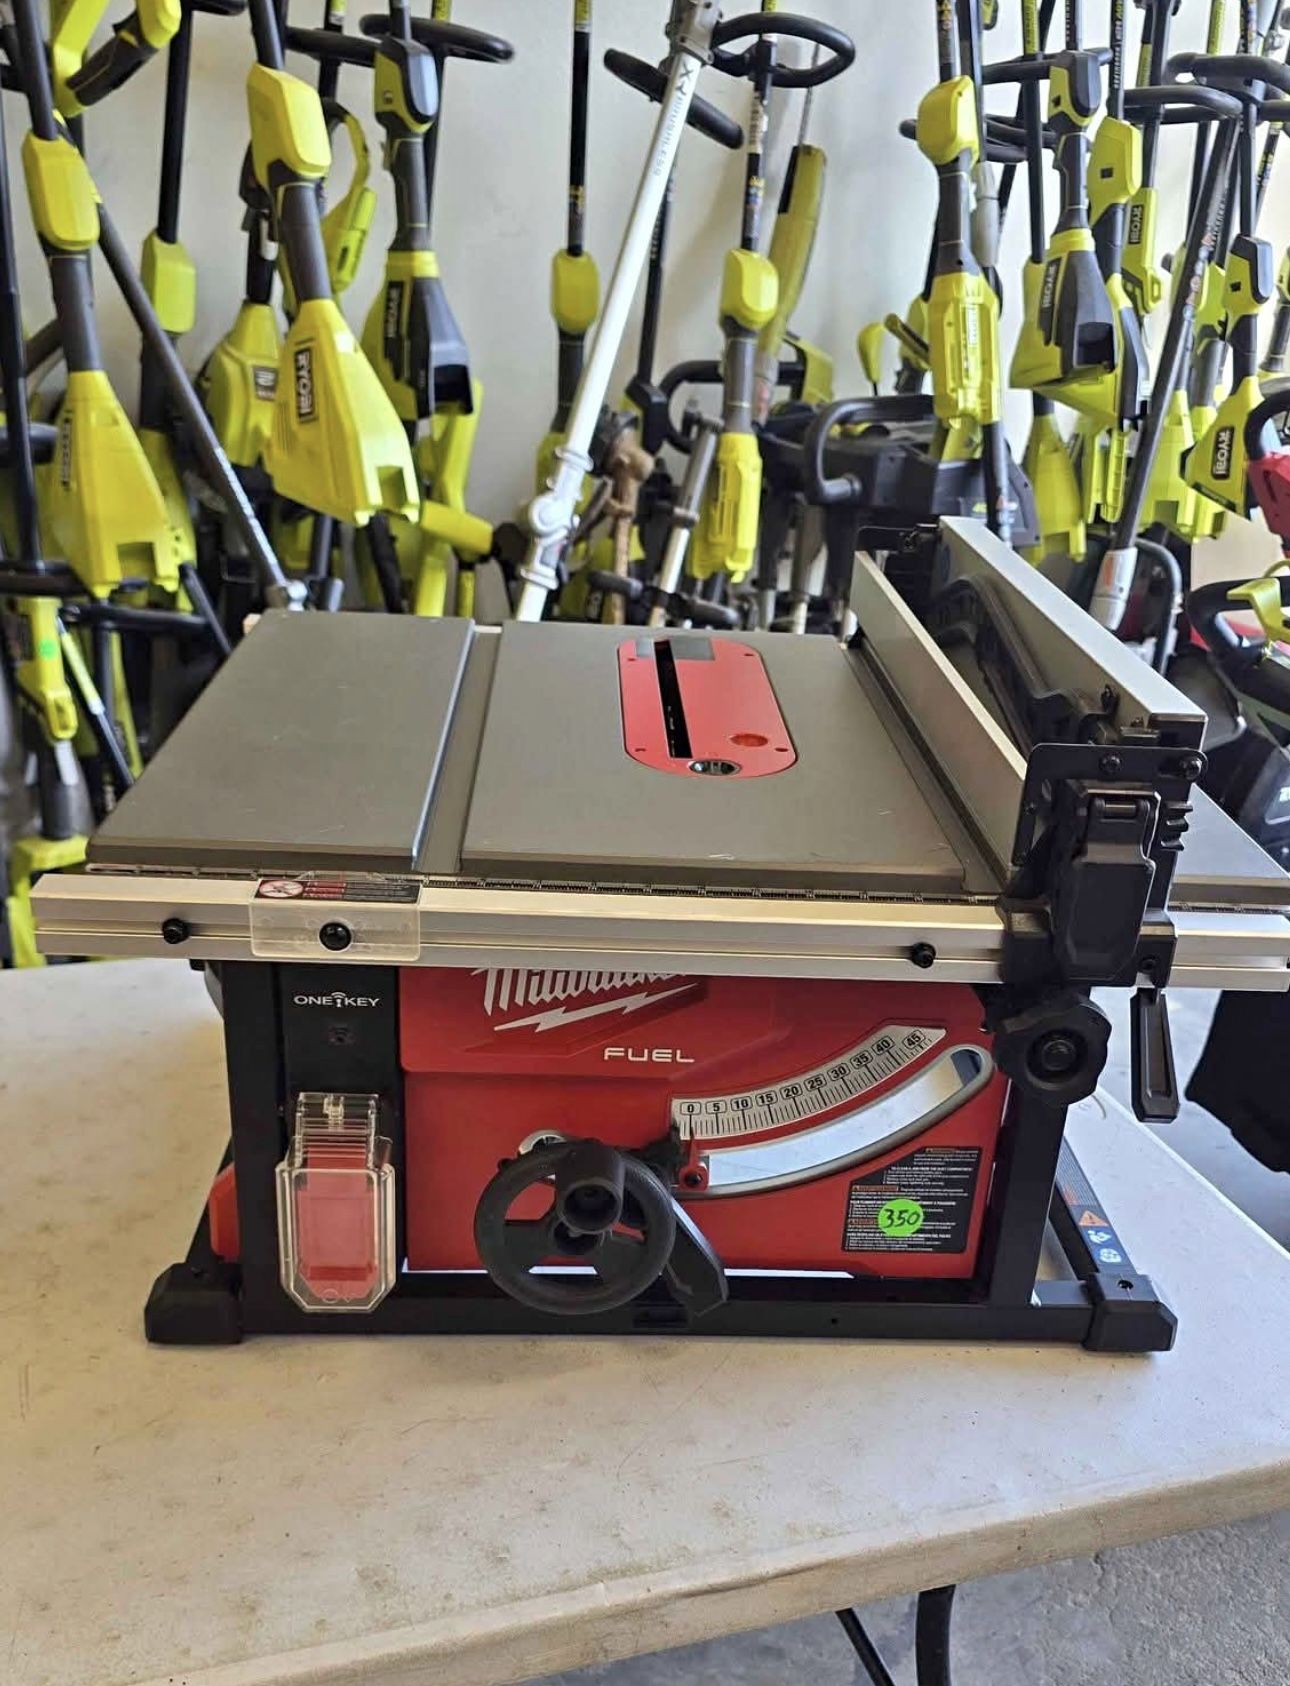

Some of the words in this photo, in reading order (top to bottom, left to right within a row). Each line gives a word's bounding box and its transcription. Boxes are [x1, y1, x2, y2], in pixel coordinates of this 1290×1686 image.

[1130, 206, 1142, 242] RYOBI
[297, 351, 312, 414] RYOBI
[1215, 429, 1231, 475] RYOBI
[604, 1047, 695, 1063] FUEL
[687, 1103, 695, 1113] 0
[713, 1102, 720, 1112] 5
[735, 1098, 749, 1109] 10
[760, 1093, 773, 1104] 15
[784, 1086, 799, 1098] 20
[808, 1077, 823, 1089] 25
[831, 1066, 847, 1079] 30
[854, 1053, 869, 1067] 35
[875, 1040, 891, 1052] 40
[907, 1033, 921, 1047] 45
[883, 1208, 920, 1229] 350
